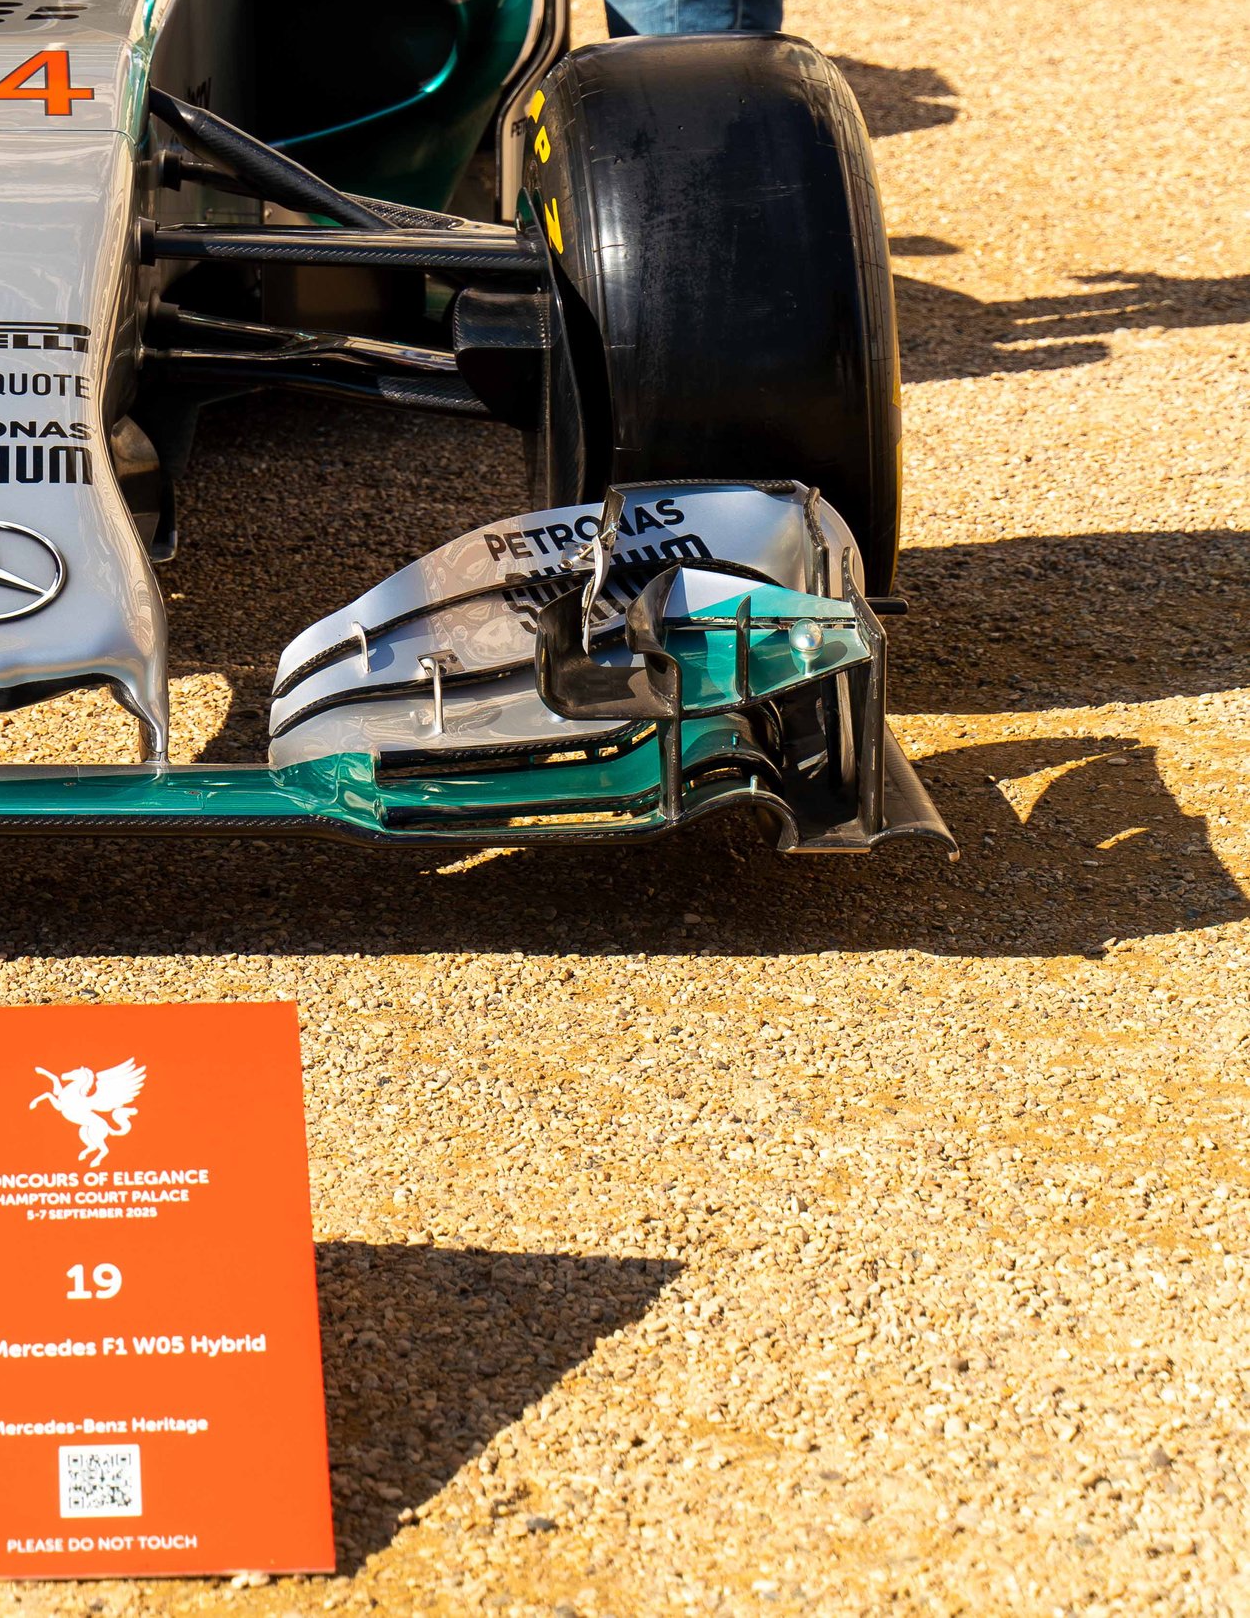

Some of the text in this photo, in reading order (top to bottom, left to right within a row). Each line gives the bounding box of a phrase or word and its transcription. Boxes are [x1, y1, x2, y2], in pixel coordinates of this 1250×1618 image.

[83, 1172, 108, 1186] OF
[113, 1169, 210, 1186] ELEGANCE
[74, 1191, 128, 1204] COURT
[131, 1189, 190, 1202] PALACE
[26, 1207, 158, 1220] 5-7 SEPTEMBER 2025
[66, 1263, 122, 1299] 19
[102, 1337, 127, 1355] F1
[132, 1336, 185, 1355] W05
[191, 1334, 266, 1357] Hybrid
[131, 1417, 209, 1435] Heritage
[6, 1535, 197, 1553] PLEASE DO NOT TOUCH
